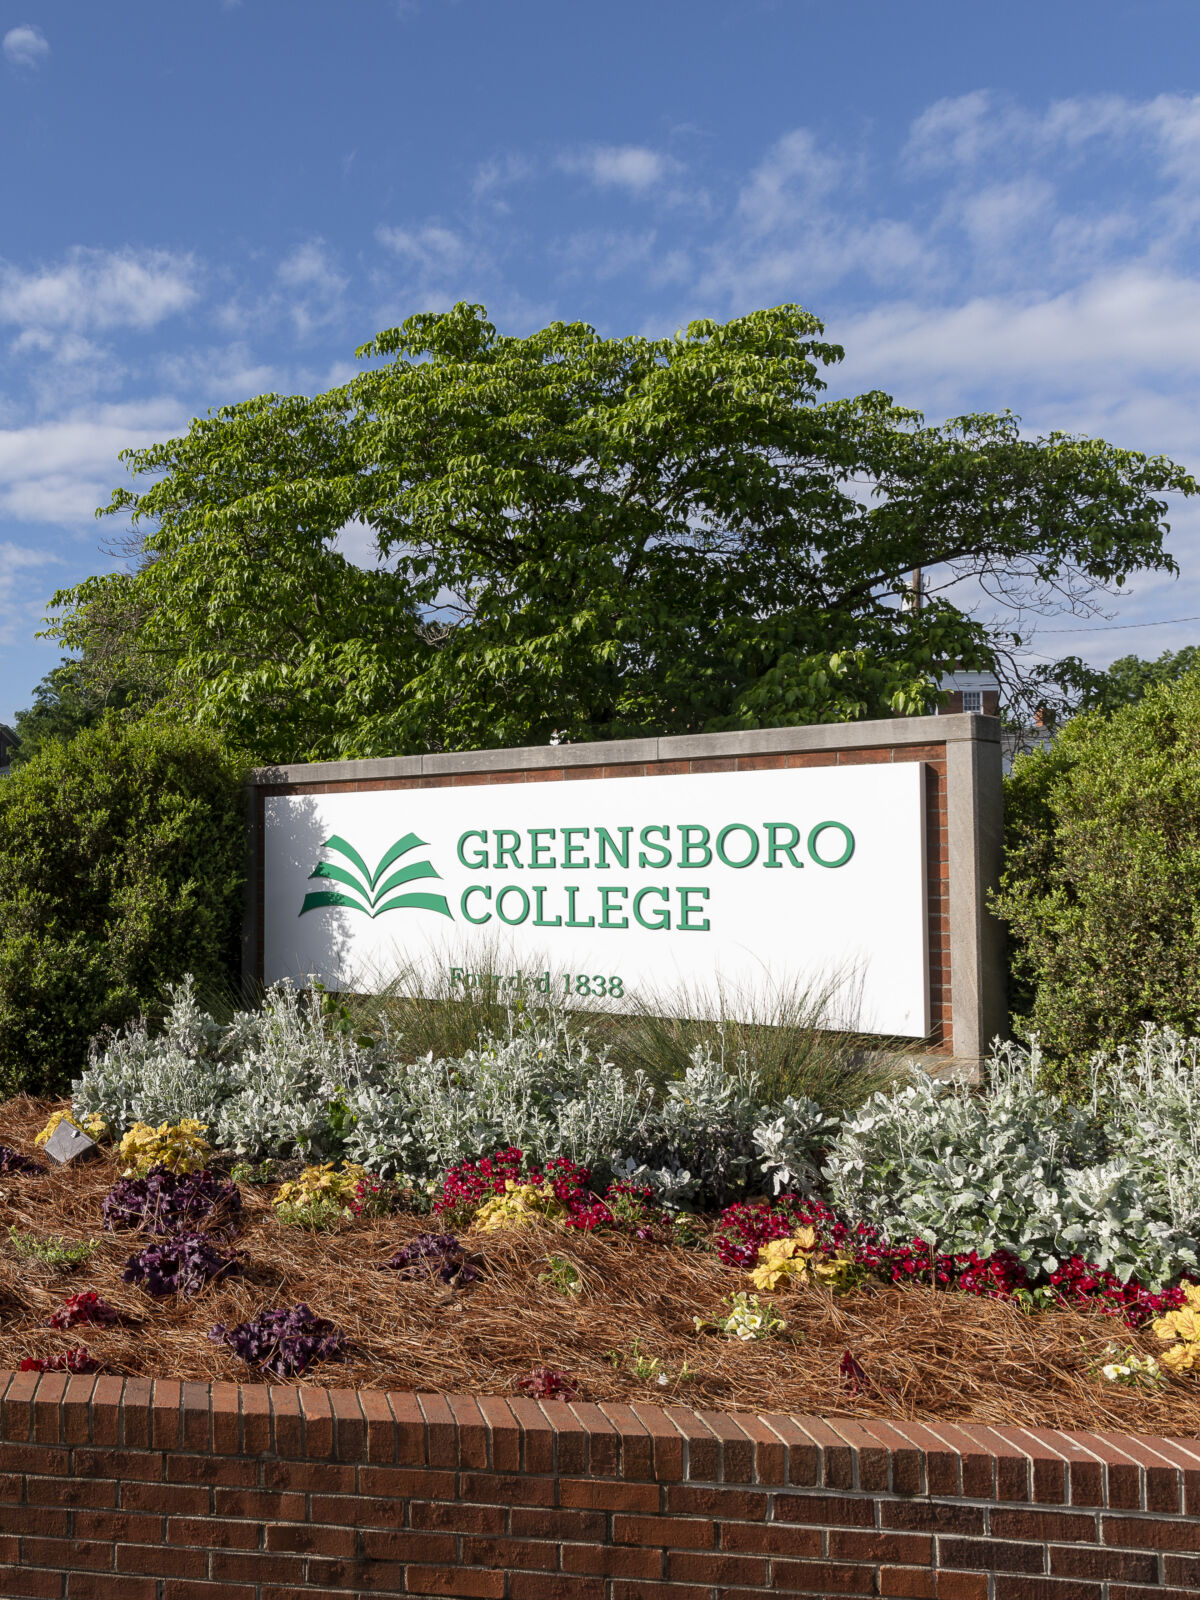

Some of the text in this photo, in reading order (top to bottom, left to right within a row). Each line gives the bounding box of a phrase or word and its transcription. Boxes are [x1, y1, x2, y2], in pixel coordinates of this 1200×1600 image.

[456, 820, 855, 869] GREENSBORO
[460, 885, 711, 931] COLLEGE
[562, 973, 625, 998] 1838
